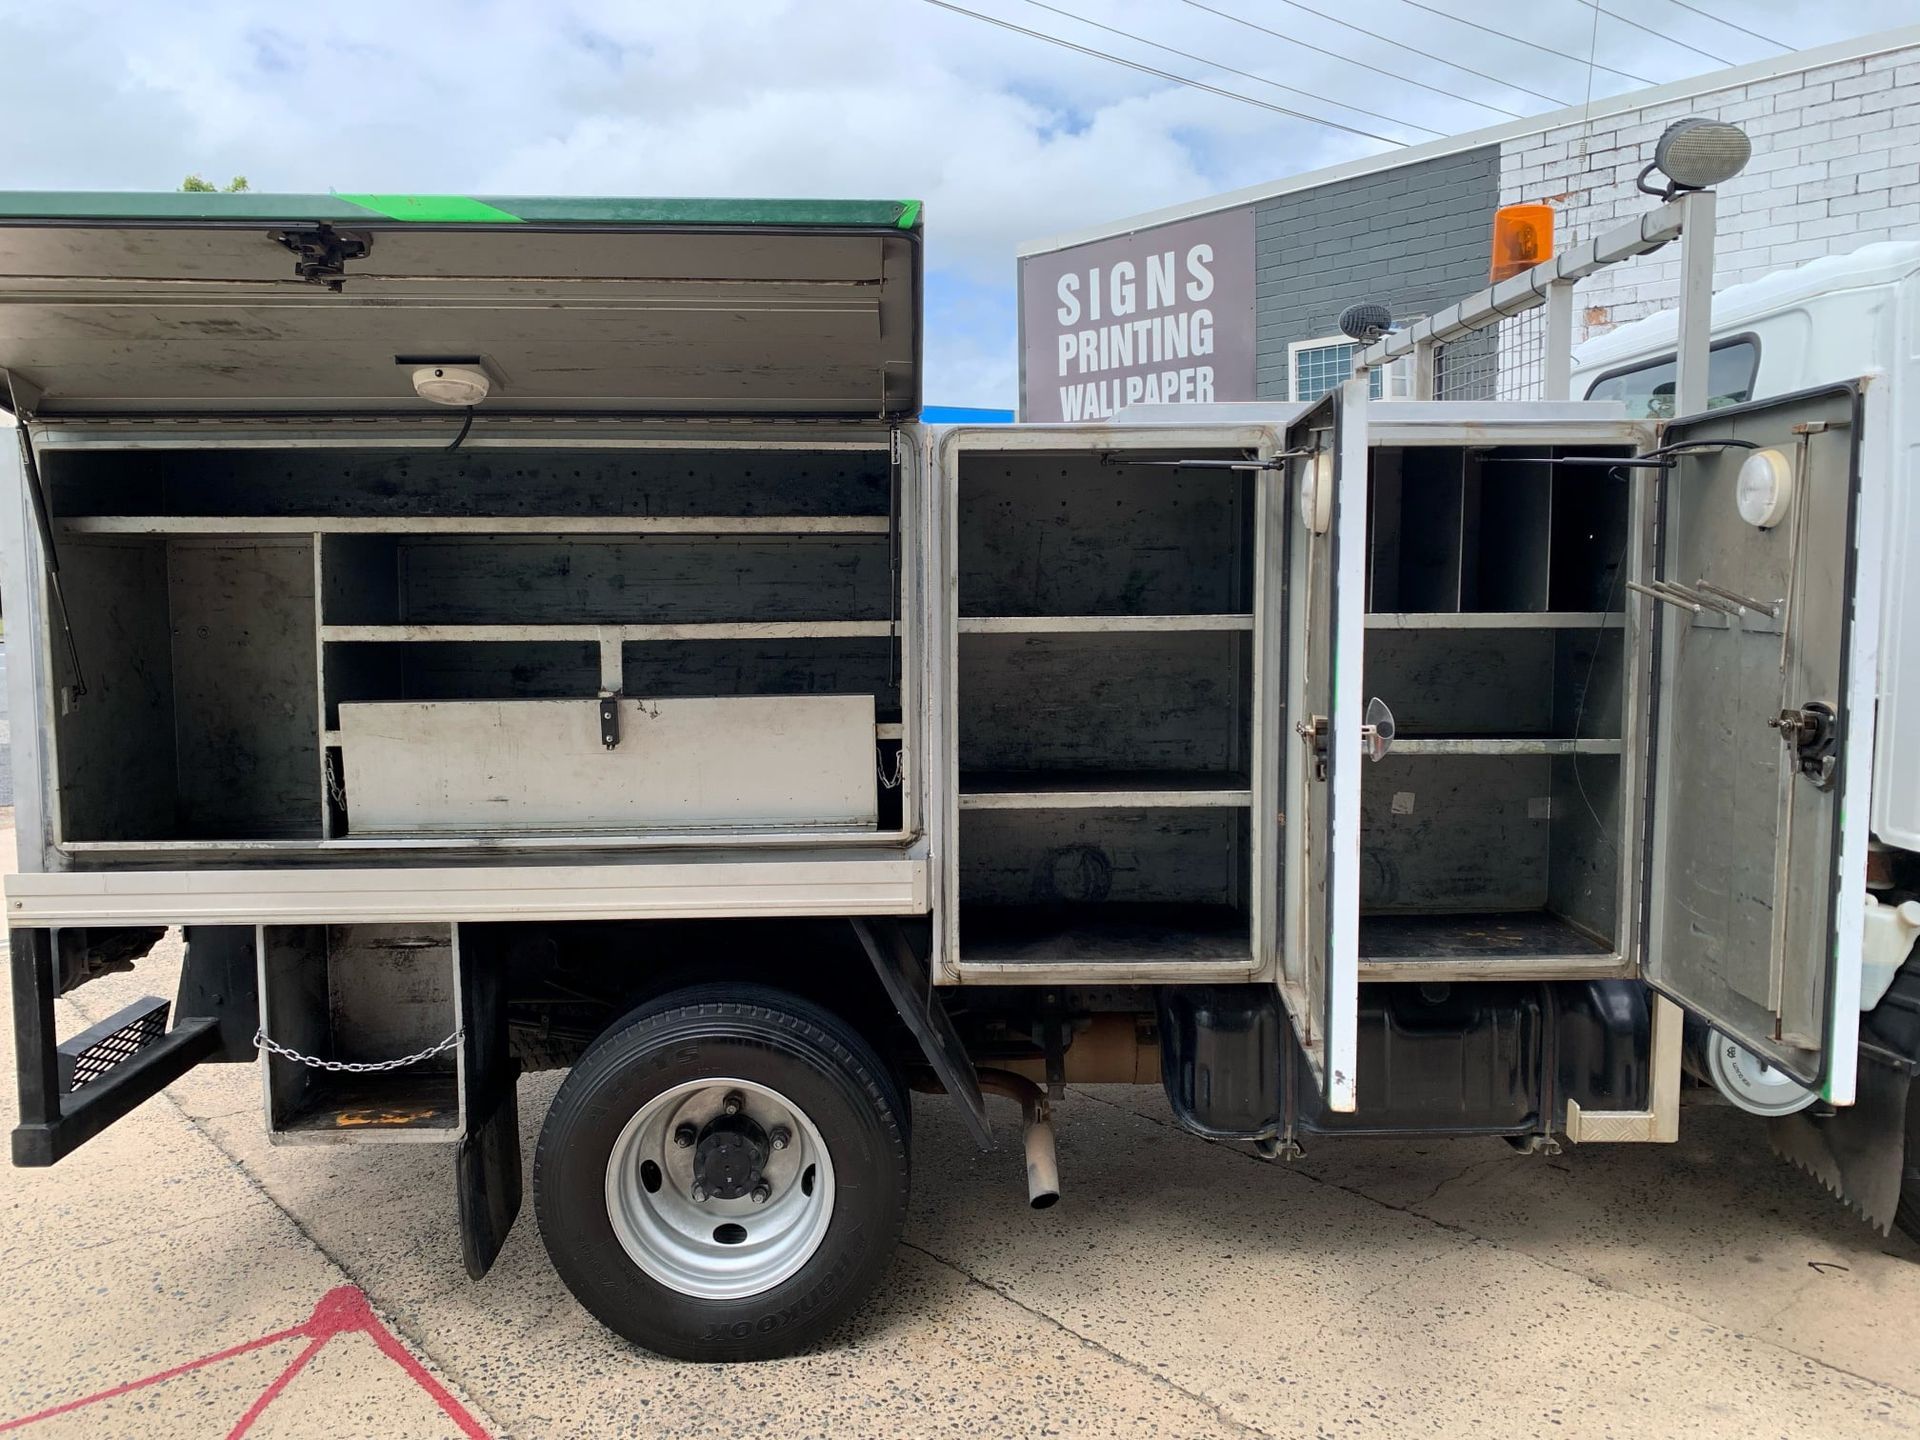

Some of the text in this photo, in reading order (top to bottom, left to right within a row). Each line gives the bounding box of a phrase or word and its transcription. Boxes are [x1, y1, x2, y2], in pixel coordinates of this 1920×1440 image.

[1057, 243, 1214, 327] SIGNS
[1058, 308, 1214, 377] PRINTING
[1059, 366, 1215, 423] WALLPAPER
